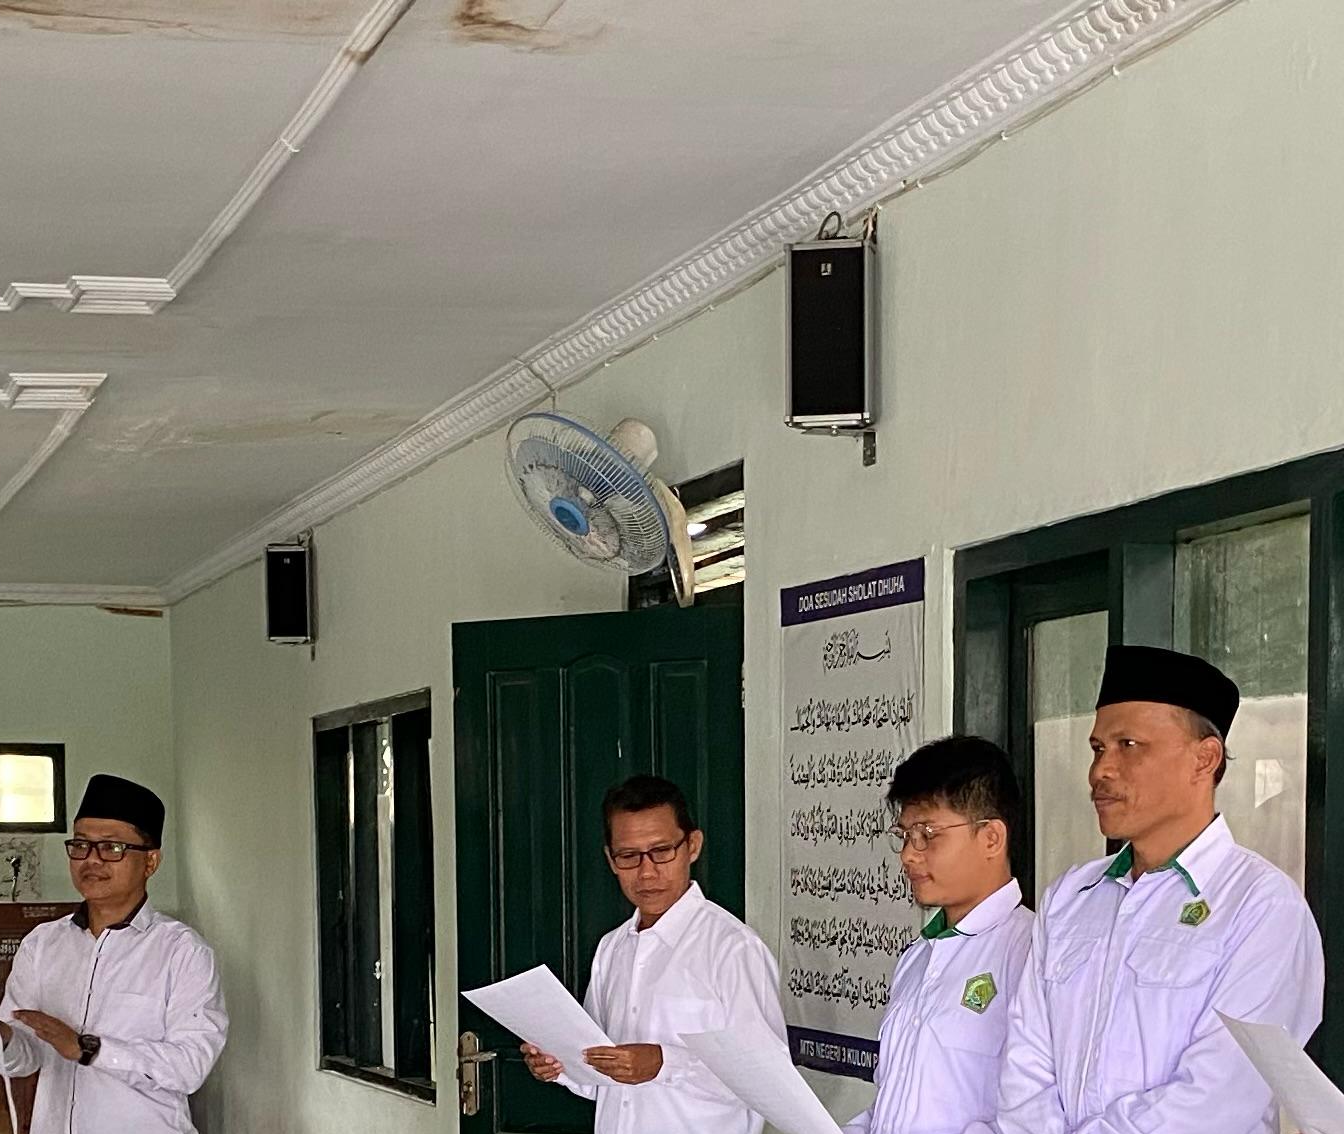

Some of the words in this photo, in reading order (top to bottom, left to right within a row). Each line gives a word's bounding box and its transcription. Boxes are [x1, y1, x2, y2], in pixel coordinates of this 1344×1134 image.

[799, 595, 814, 612] DOA
[814, 587, 848, 609] SESUDAH
[848, 581, 877, 602] SHOLAT
[877, 575, 905, 597] DHUHA
[799, 1038, 815, 1057] MTS
[815, 1042, 841, 1062] NEGERI
[841, 1047, 847, 1063] 3
[847, 1047, 872, 1068] KULON
